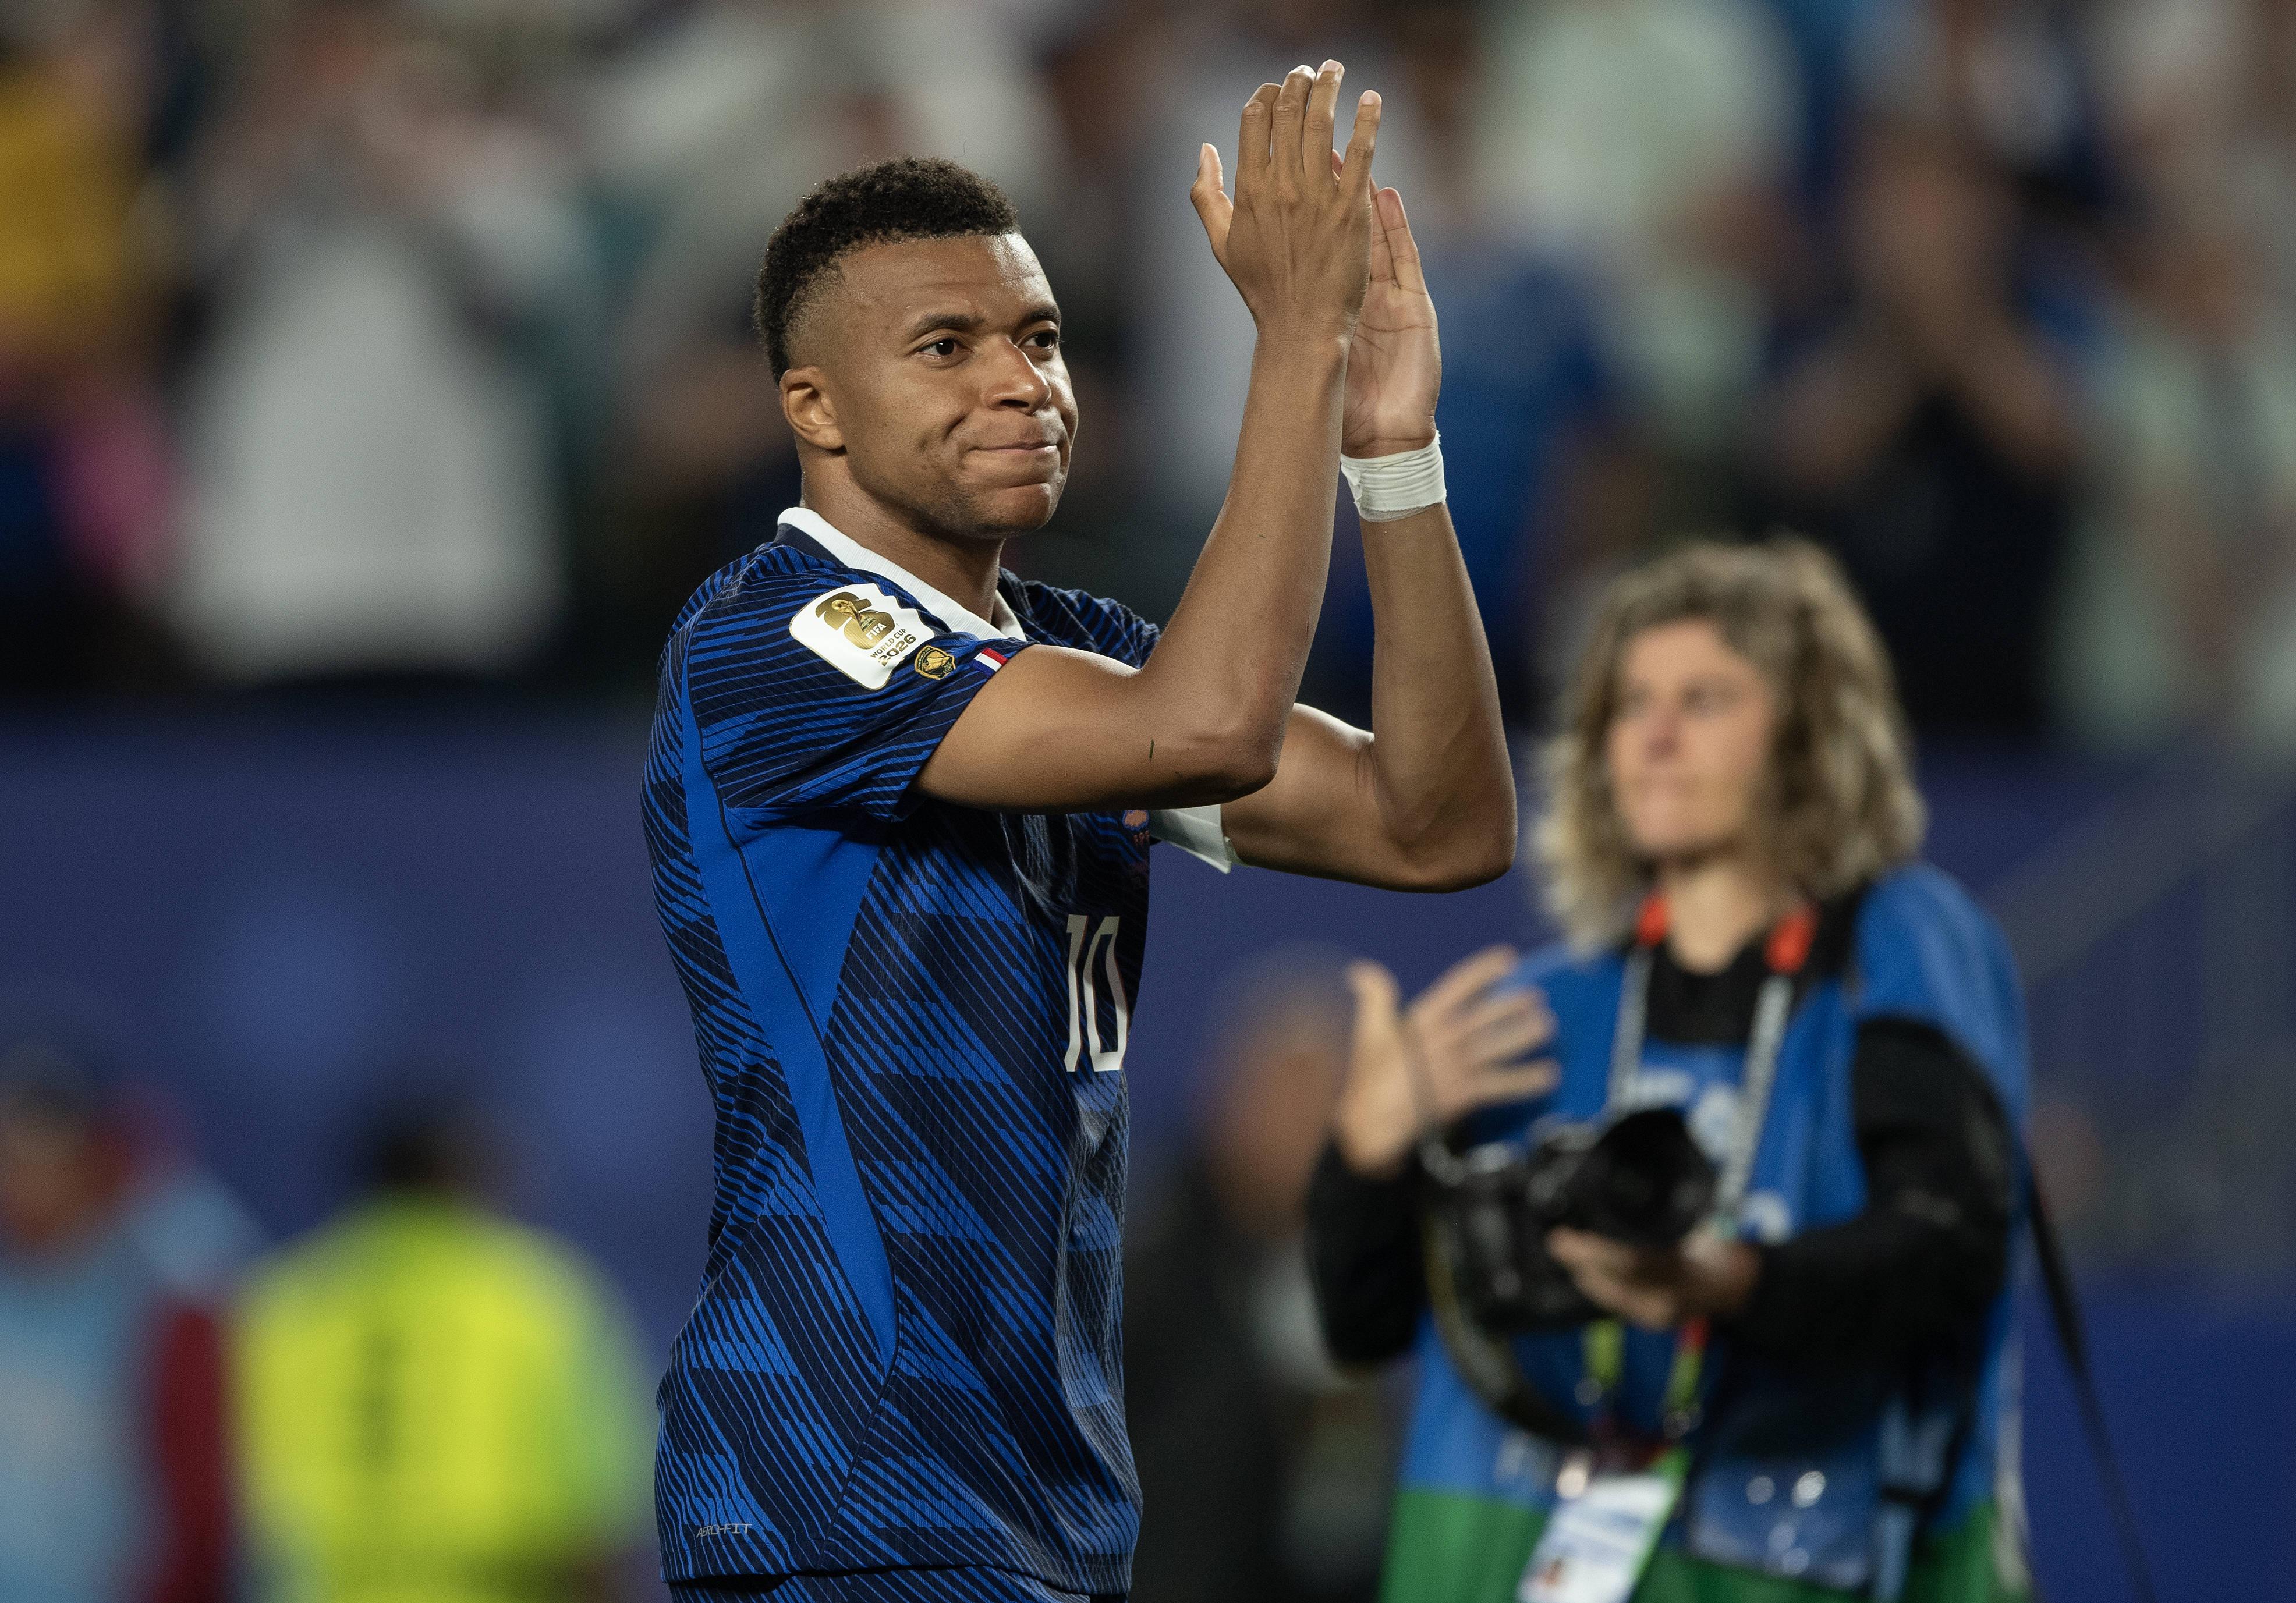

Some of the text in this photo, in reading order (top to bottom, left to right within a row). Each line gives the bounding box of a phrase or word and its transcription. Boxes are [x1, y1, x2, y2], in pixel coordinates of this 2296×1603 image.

[866, 623, 887, 640] FIFA
[870, 628, 906, 658] WORLD CUP
[878, 634, 916, 666] 2026
[1064, 914, 1128, 1072] 10
[696, 1523, 752, 1538] AERO-FIT
